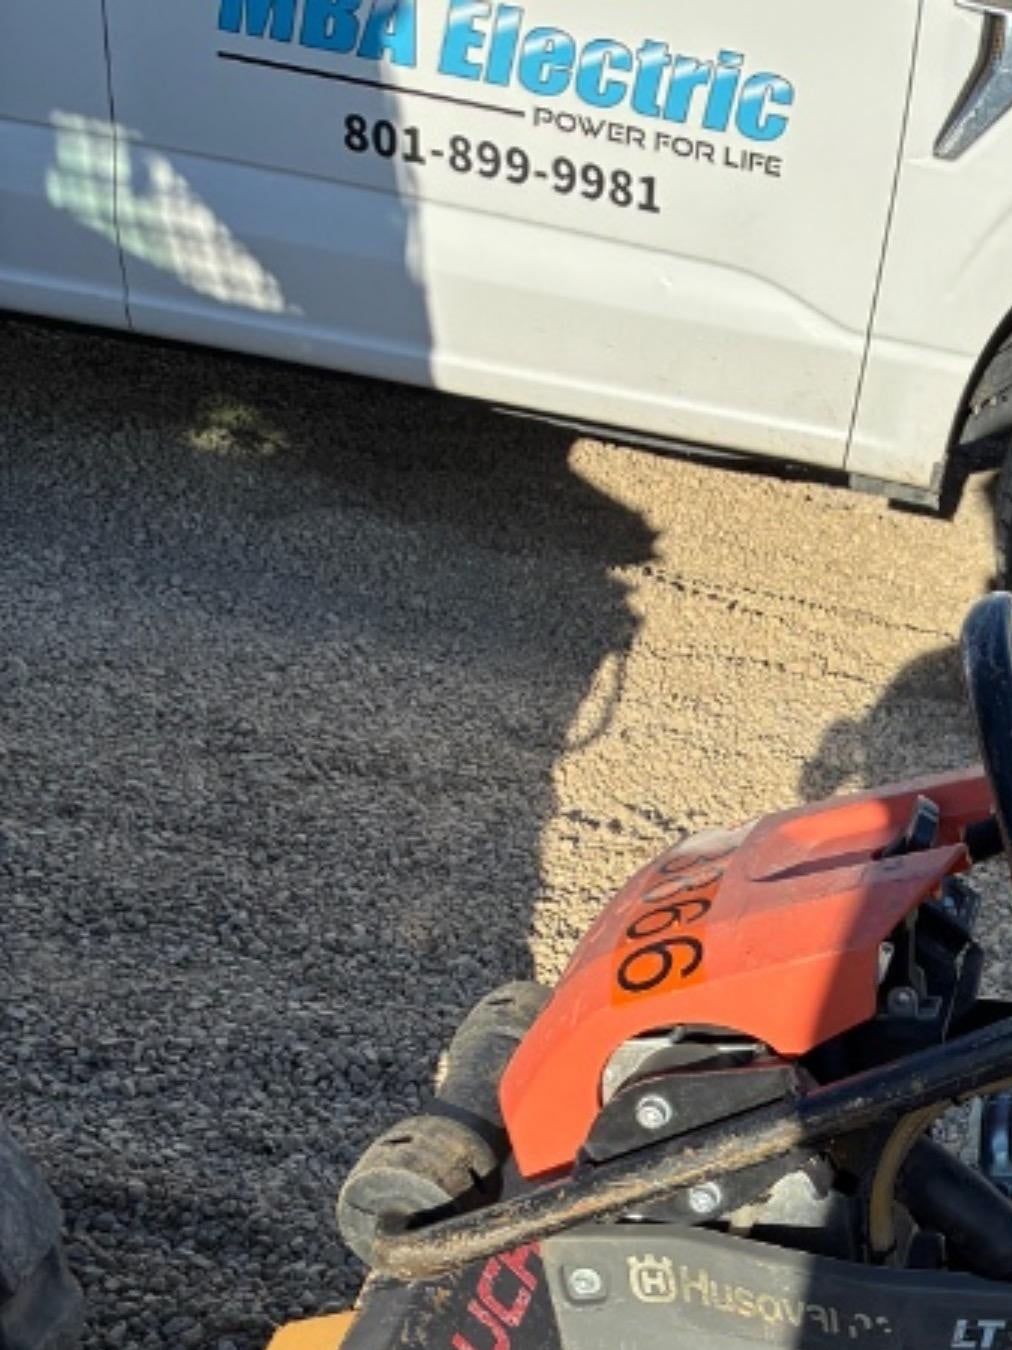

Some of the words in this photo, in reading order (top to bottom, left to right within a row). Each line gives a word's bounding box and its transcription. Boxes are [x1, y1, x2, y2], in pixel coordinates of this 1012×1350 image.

[217, 0, 417, 69] MBA
[438, 0, 795, 142] Electric
[344, 112, 661, 214] 801-899-9981
[533, 106, 646, 150] POWER
[653, 131, 715, 165] FOR
[722, 146, 783, 178] LIFE
[951, 1319, 1006, 1349] LT
